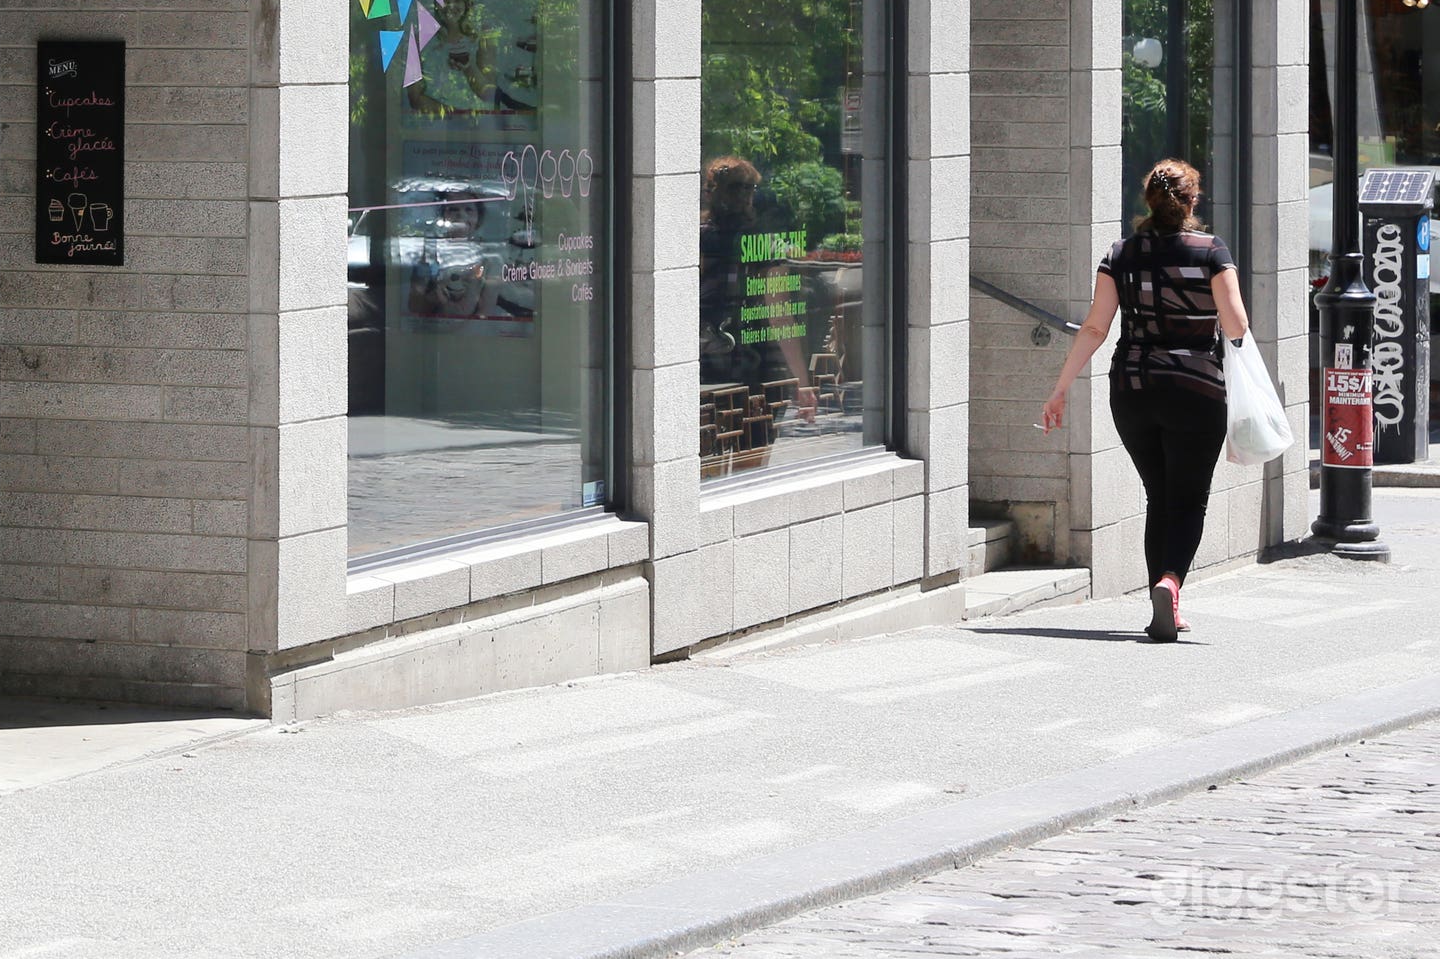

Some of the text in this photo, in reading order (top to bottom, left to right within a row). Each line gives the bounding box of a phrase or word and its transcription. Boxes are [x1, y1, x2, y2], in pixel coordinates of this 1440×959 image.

[49, 91, 114, 118] Cupcakes
[50, 120, 96, 139] Crème
[68, 137, 116, 161] glacée
[52, 166, 99, 188] Cafés
[51, 231, 94, 245] Bonne
[558, 232, 594, 254] Cupcakes
[741, 223, 807, 264] SALON DE THÉ
[502, 257, 594, 282] Crème Glacée & Sorbets
[571, 283, 594, 302] Cafés
